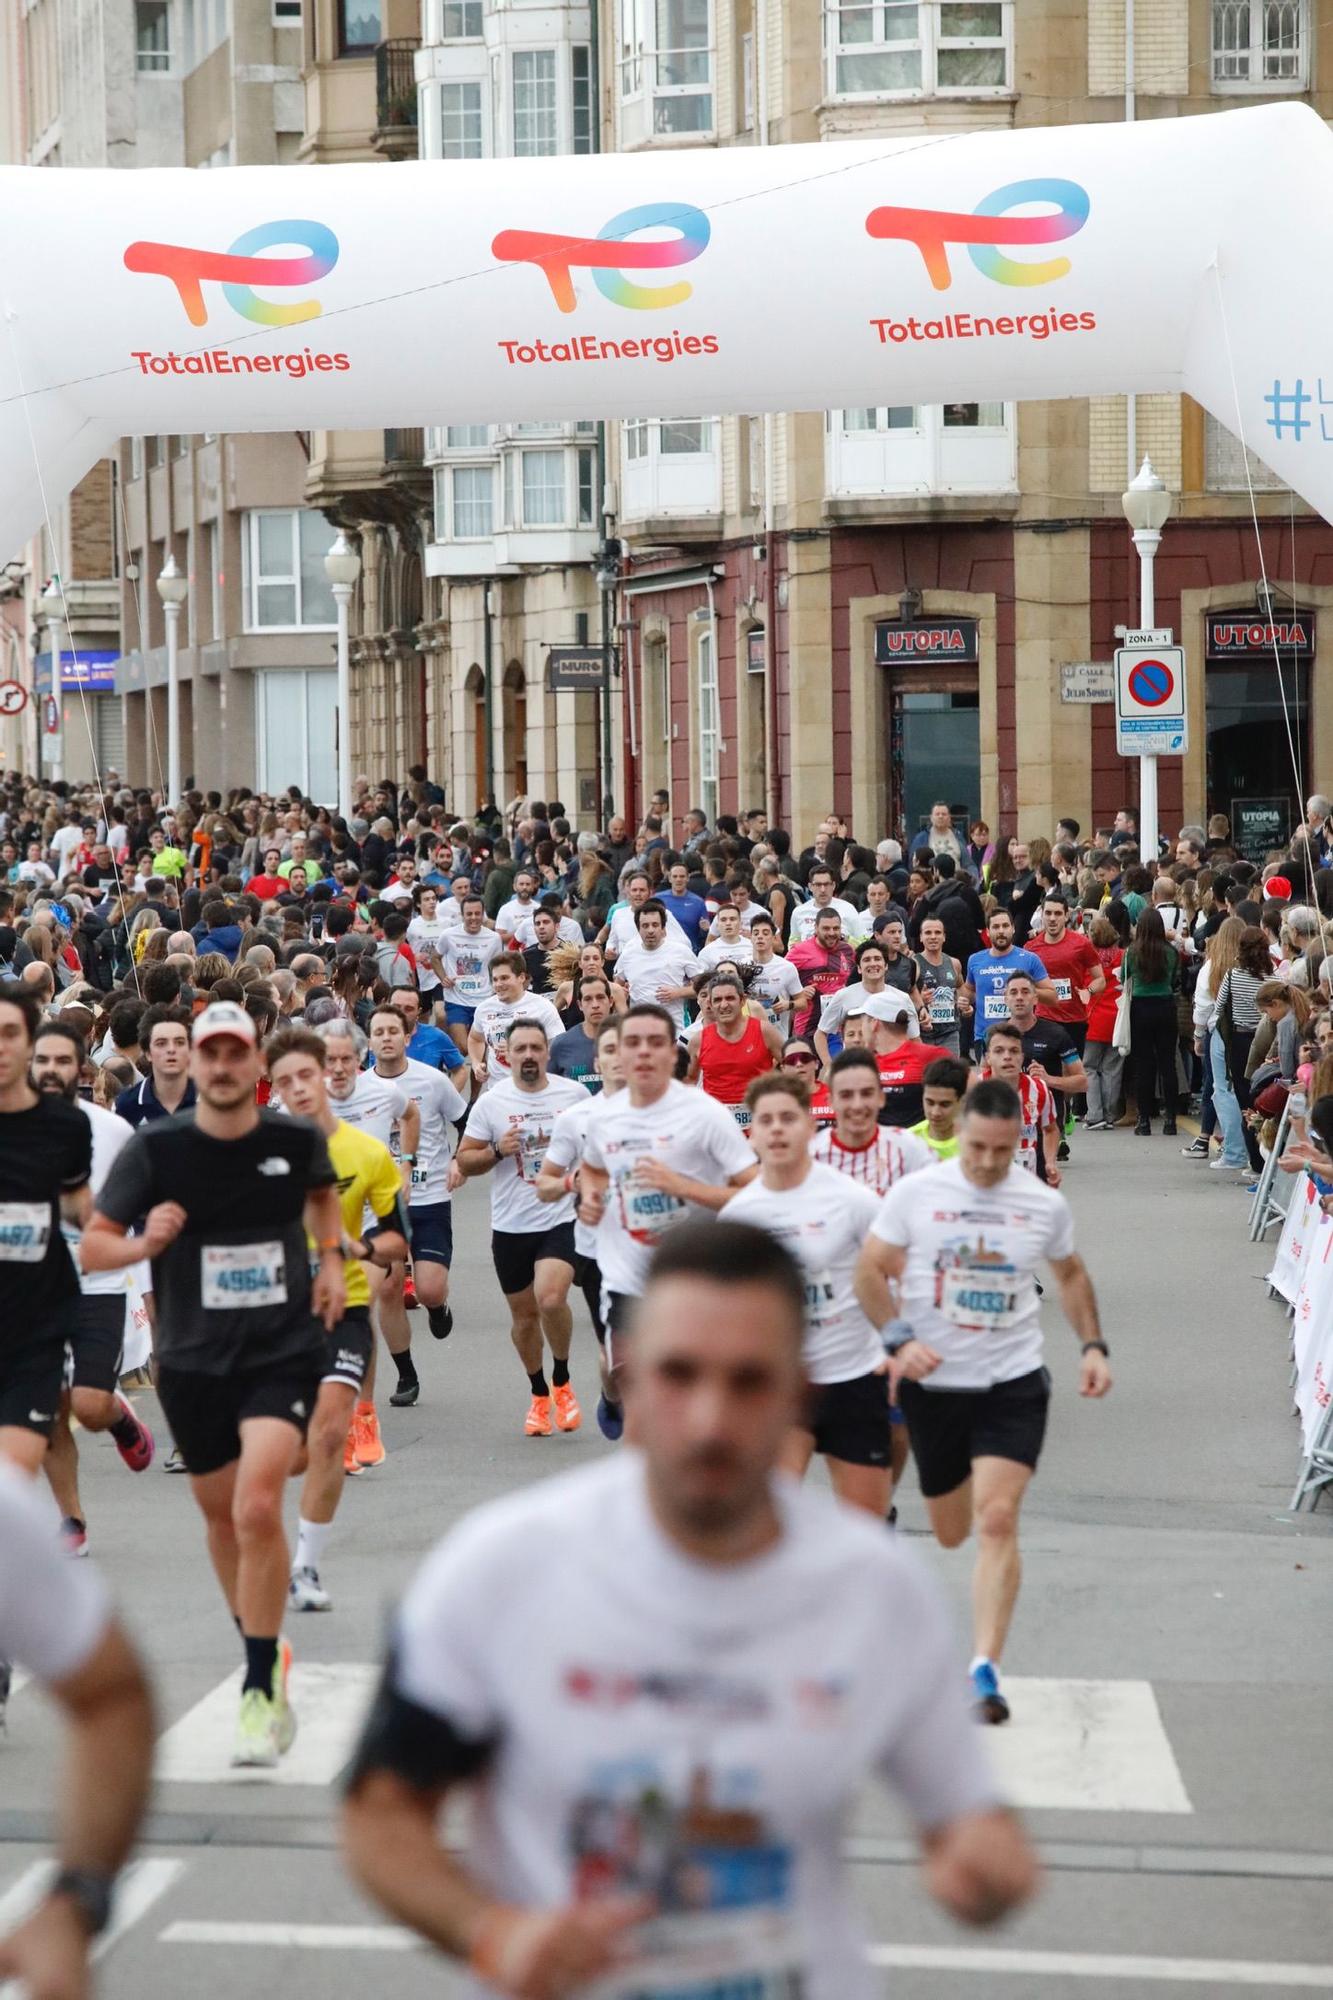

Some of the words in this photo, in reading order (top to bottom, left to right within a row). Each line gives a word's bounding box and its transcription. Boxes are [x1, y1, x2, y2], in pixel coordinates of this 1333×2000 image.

[869, 306, 1097, 344] TotalEnergies
[498, 329, 720, 364] TotalEnergies
[131, 347, 351, 379] TotalEnergies
[886, 628, 966, 652] UTOPIA
[1128, 634, 1154, 644] ZONA
[1213, 623, 1308, 646] UTOPIA
[1241, 810, 1280, 822] UTOPIA
